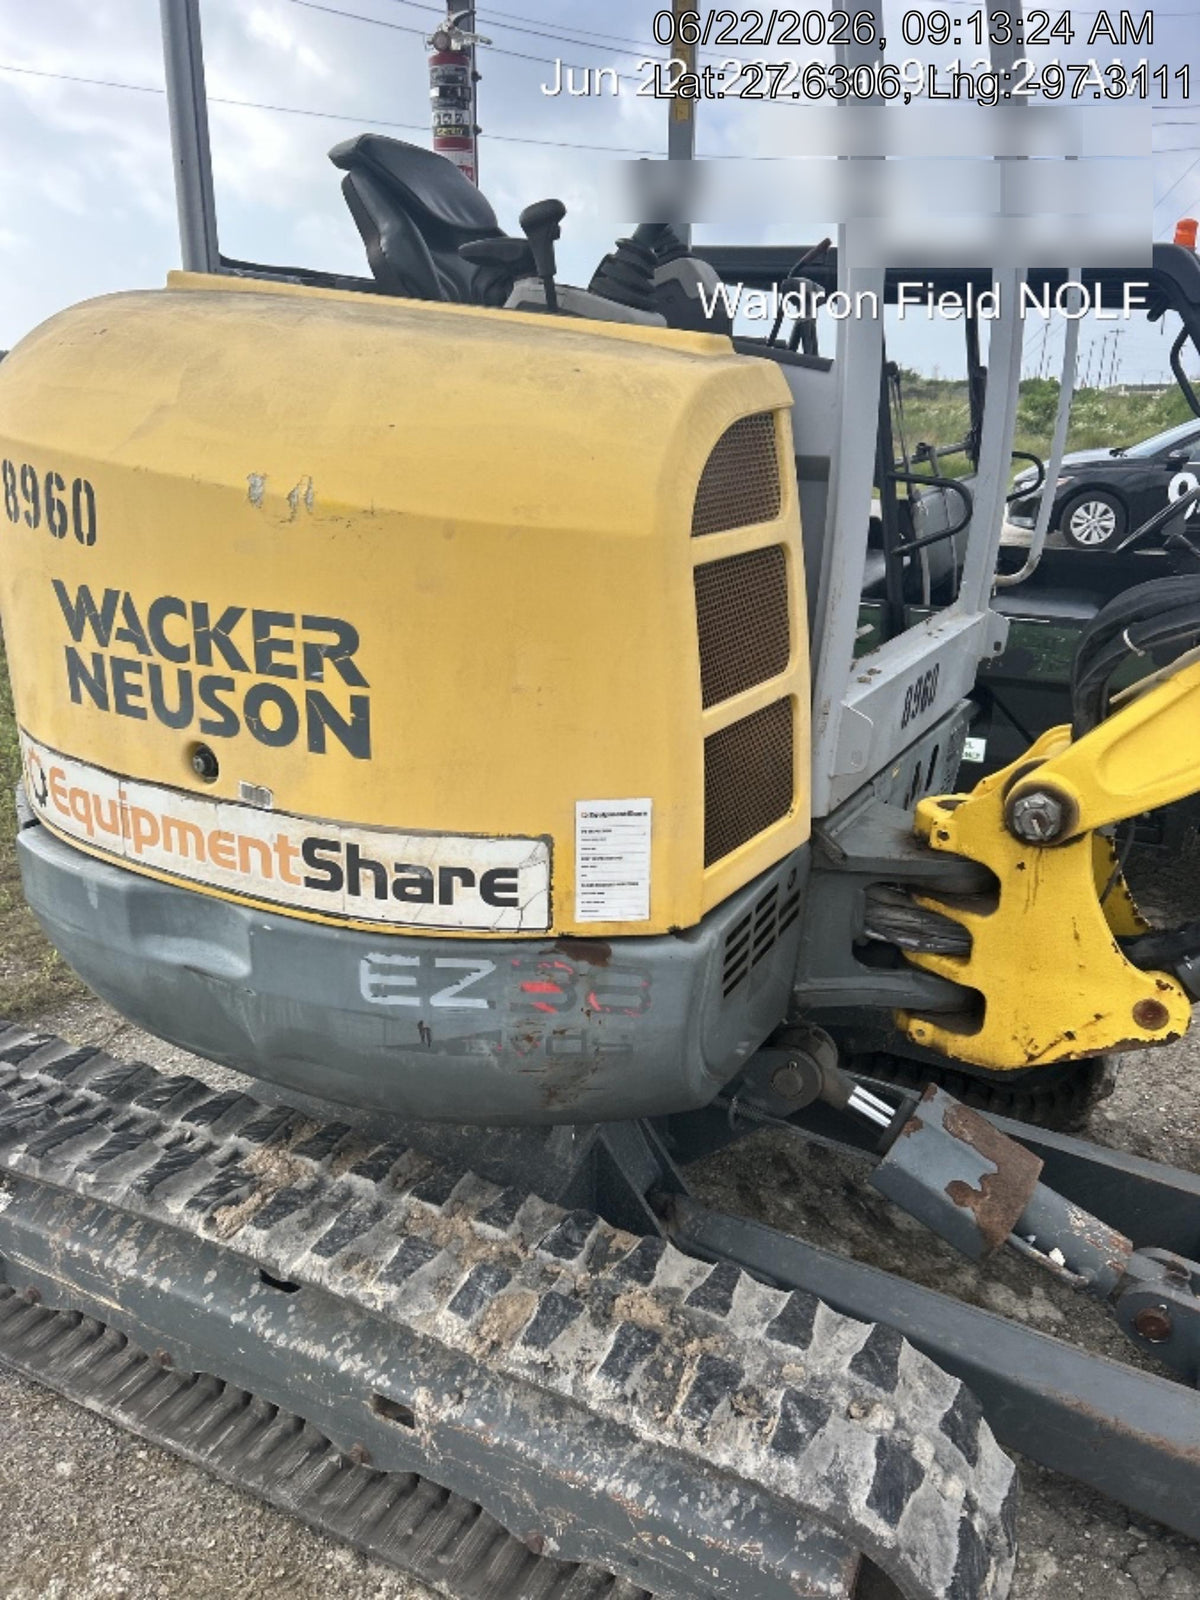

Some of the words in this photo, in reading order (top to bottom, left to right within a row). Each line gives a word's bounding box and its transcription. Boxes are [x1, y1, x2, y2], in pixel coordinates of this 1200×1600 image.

[2, 458, 97, 547] 8960
[51, 578, 371, 689] WACKER
[64, 644, 372, 760] NEUSON
[48, 766, 520, 908] EquipmentShare
